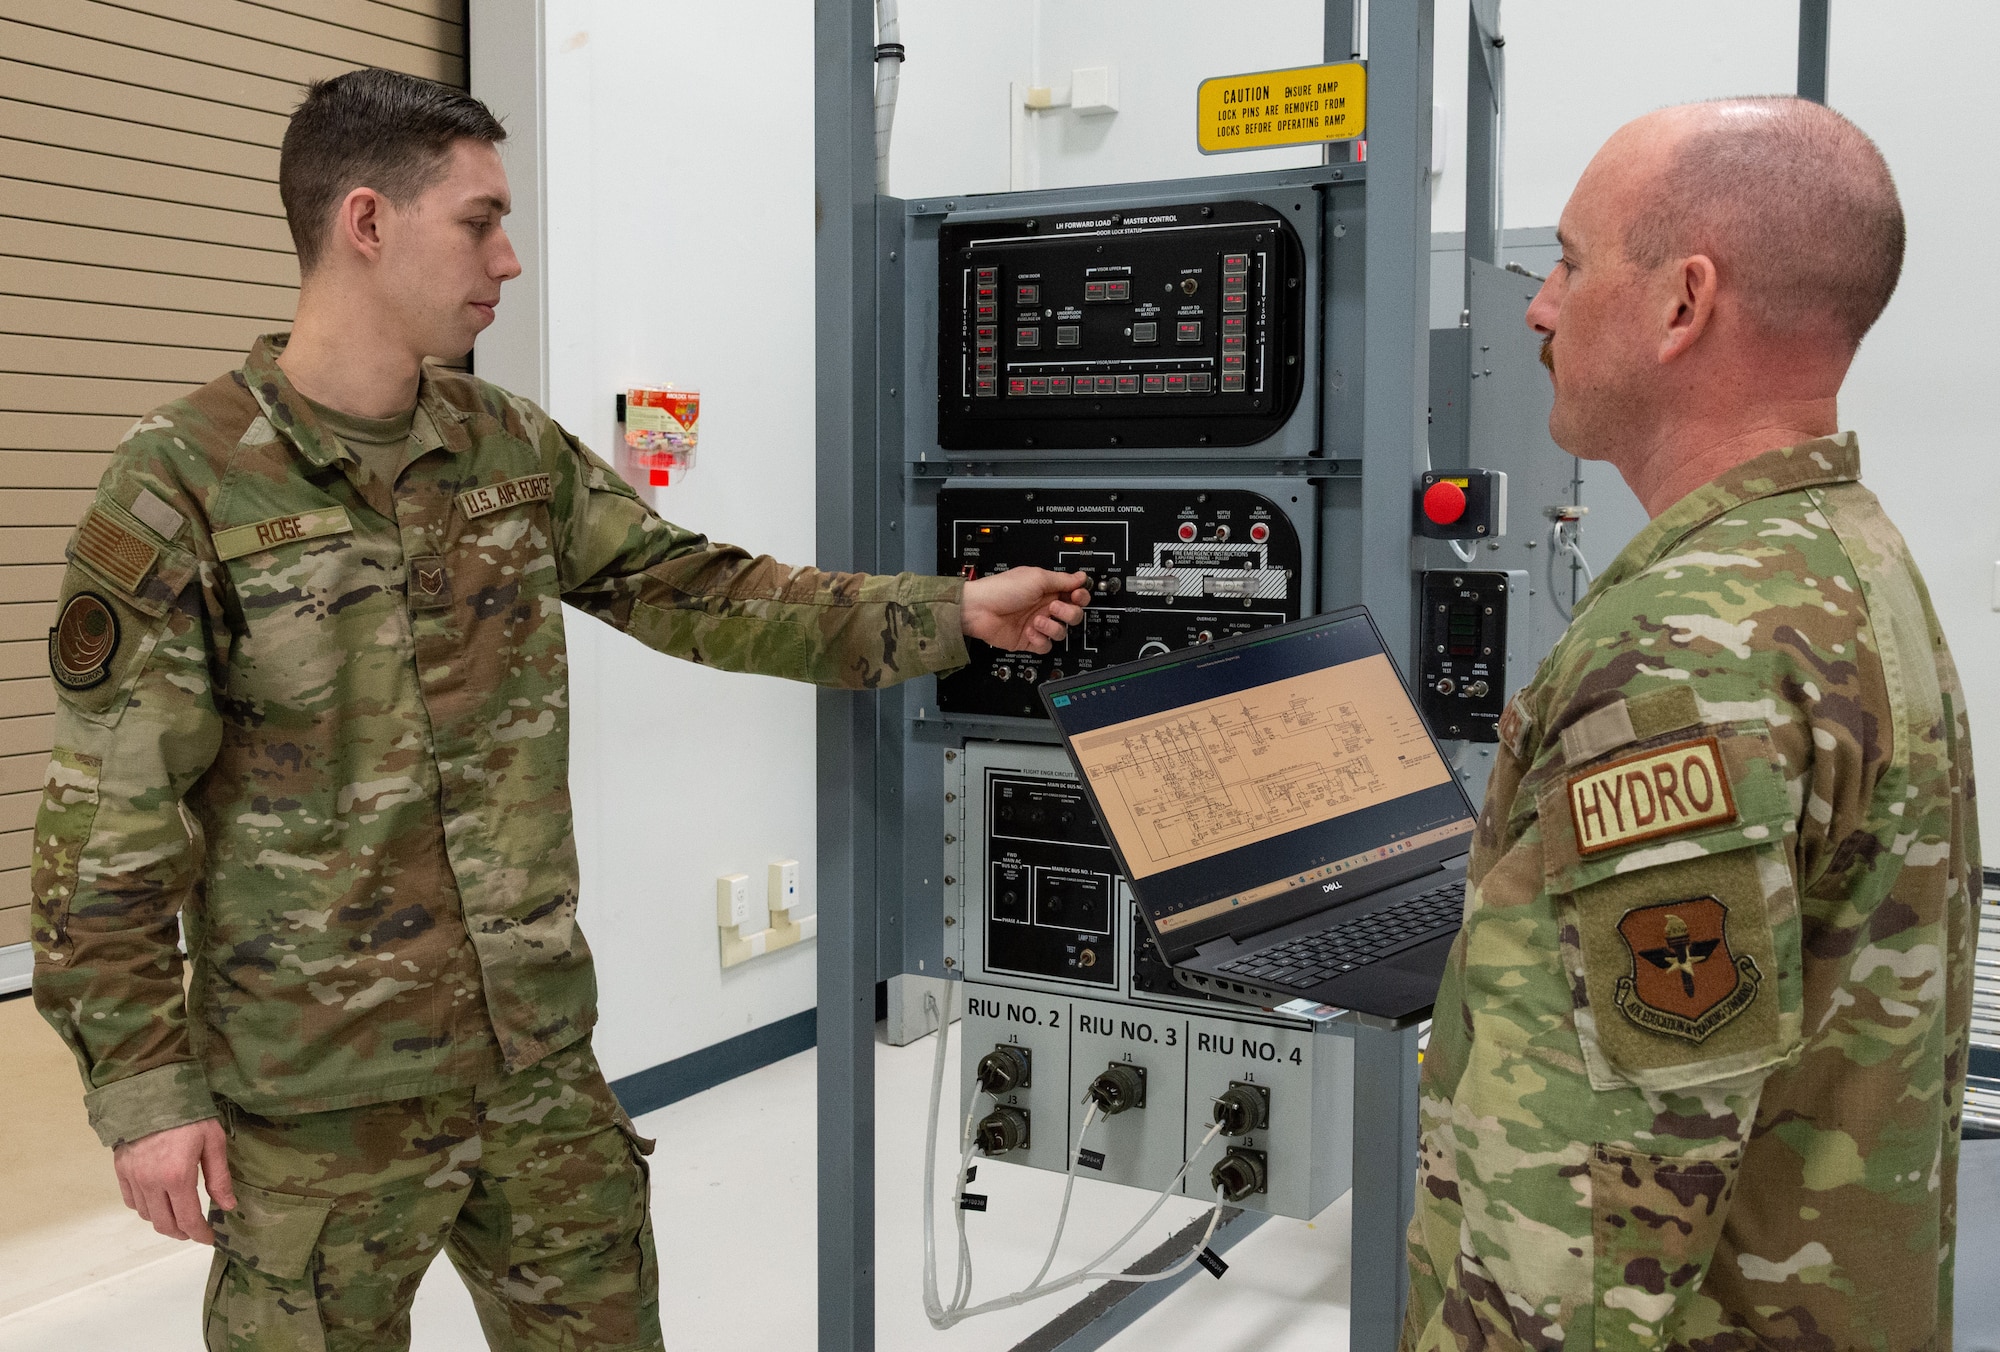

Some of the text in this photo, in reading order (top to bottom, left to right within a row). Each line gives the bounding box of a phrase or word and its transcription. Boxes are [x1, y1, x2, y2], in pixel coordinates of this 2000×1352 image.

[1223, 81, 1339, 105] CAUTION ENSURE RAMP
[1218, 97, 1346, 121] LOCK PINS ARE REMOVED FROM
[1217, 114, 1346, 138] LOCKS BEFORE OPERATING RAMP
[1064, 220, 1094, 229] FORWARD
[1123, 216, 1148, 225] MASTER
[1148, 215, 1177, 223] CONTROL
[465, 477, 552, 514] U.S. AIR FORCE
[256, 515, 306, 546] ROSE
[67, 669, 102, 684] SQUADRON
[1577, 754, 1714, 841] HYDRO
[1322, 881, 1343, 893] DELL
[1078, 934, 1098, 943] LAMP TEST
[968, 998, 1060, 1028] RIU NO. 2
[1008, 1034, 1018, 1044] J1
[1079, 1014, 1177, 1046] RIU NO. 3
[1122, 1052, 1133, 1063] J1
[1198, 1032, 1302, 1066] RIU NO. 4
[1243, 1072, 1255, 1082] J1
[1008, 1095, 1017, 1104] J3
[1242, 1136, 1253, 1147] J3
